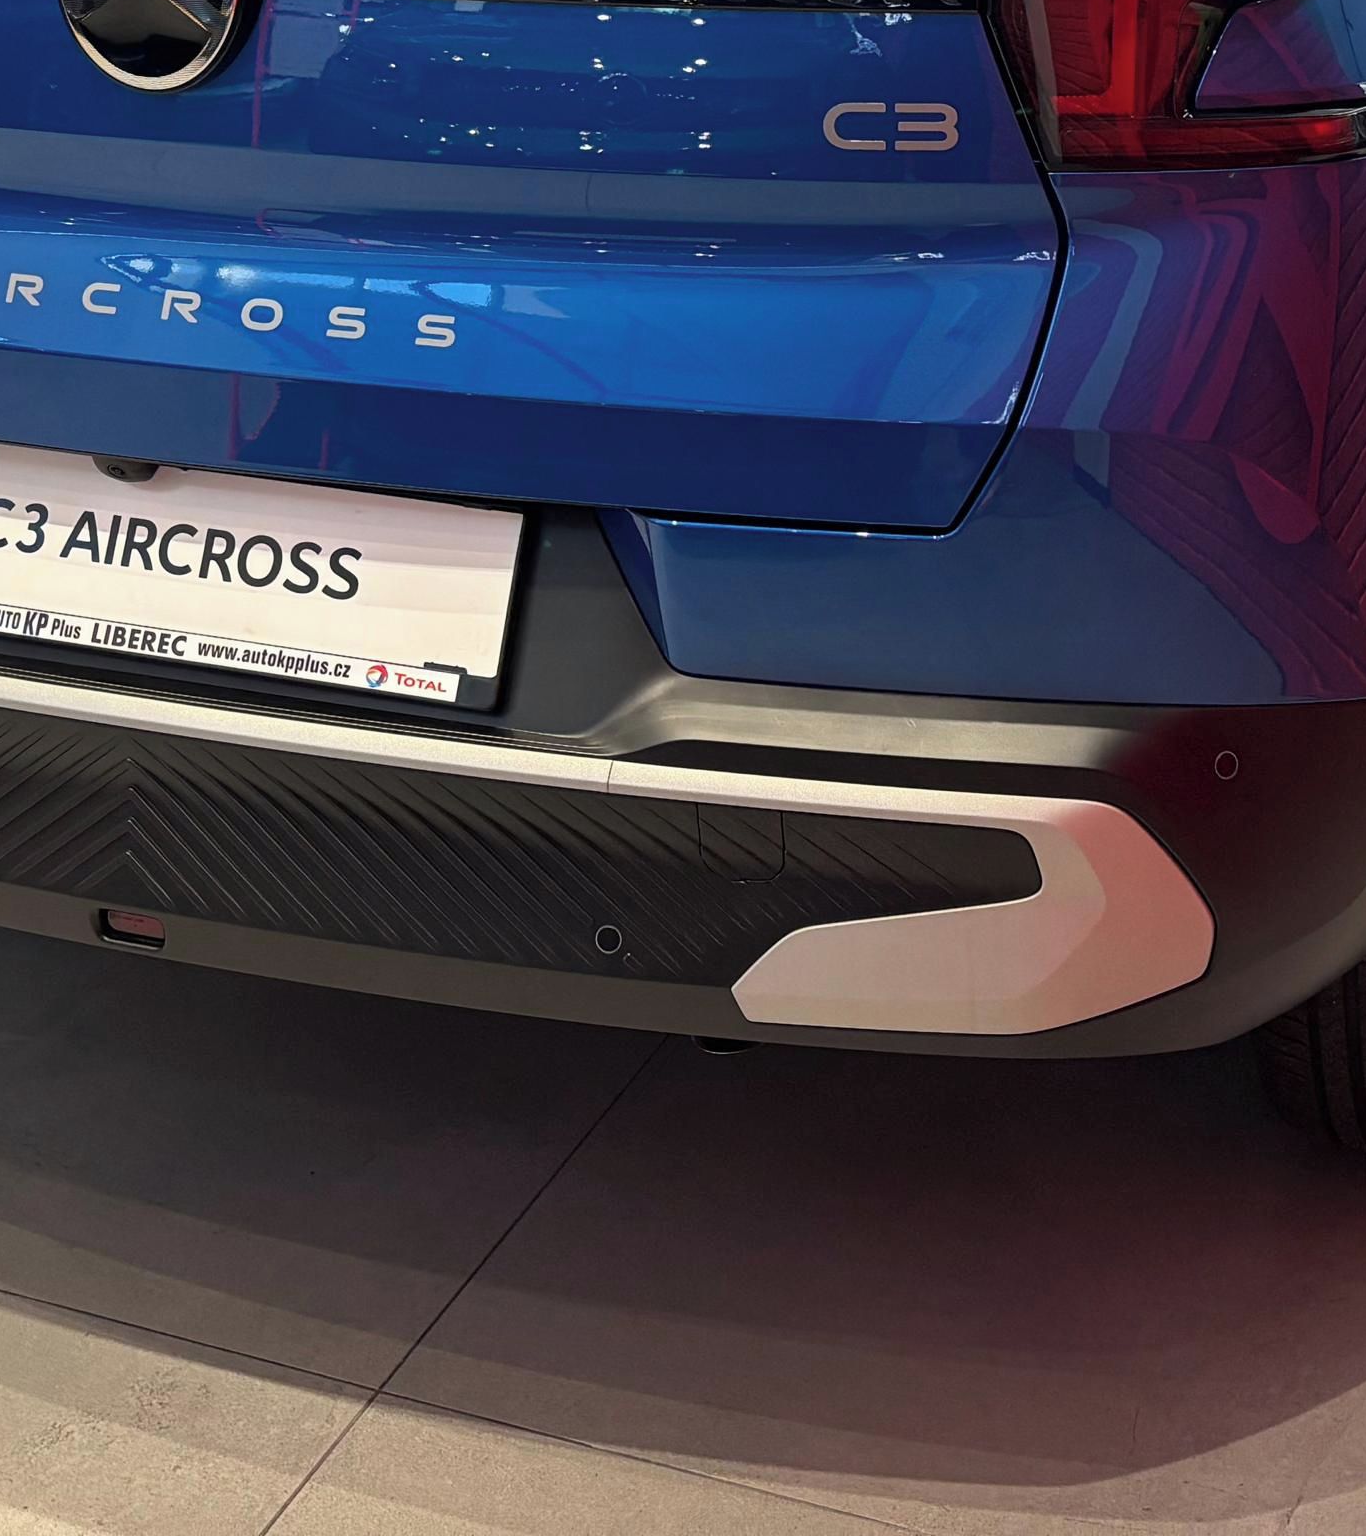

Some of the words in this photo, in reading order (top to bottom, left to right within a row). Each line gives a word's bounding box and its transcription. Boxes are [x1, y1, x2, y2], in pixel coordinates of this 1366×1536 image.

[822, 102, 960, 151] C3
[59, 510, 364, 601] AIRCROSS
[22, 610, 50, 636] KP
[50, 618, 82, 640] Plus
[90, 622, 188, 657] LIBEREC
[197, 642, 352, 679] www.autokpplus.cz
[394, 672, 447, 693] TOTAL
